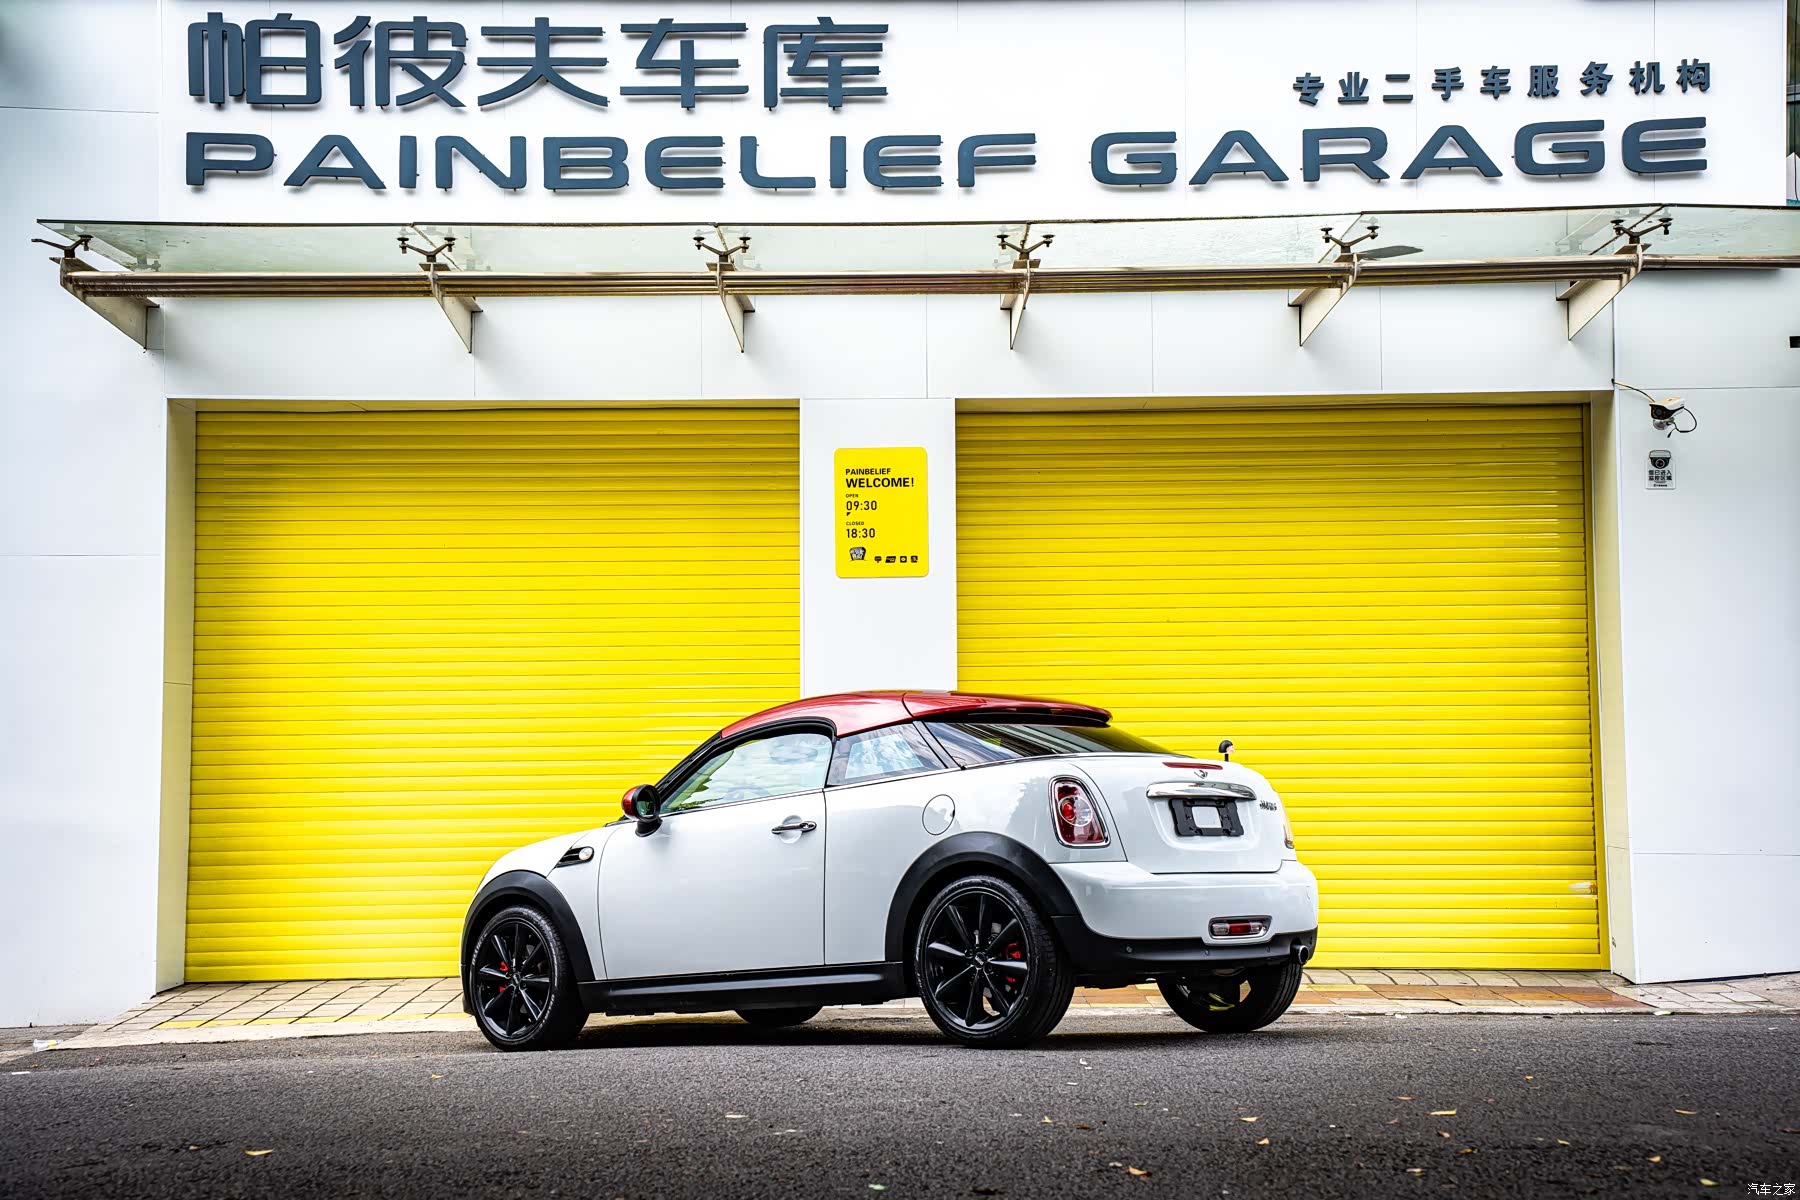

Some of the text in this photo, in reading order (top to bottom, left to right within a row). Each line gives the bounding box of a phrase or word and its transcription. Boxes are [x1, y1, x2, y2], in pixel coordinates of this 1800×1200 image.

[187, 12, 888, 110] 帕彼夫车库
[1293, 58, 1711, 106] 专业二手车服务机构
[186, 117, 1707, 191] PAINBELIEF GARAGE
[845, 477, 914, 488] WELCOME!
[846, 501, 877, 511] 09:30
[846, 528, 876, 539] 18:30
